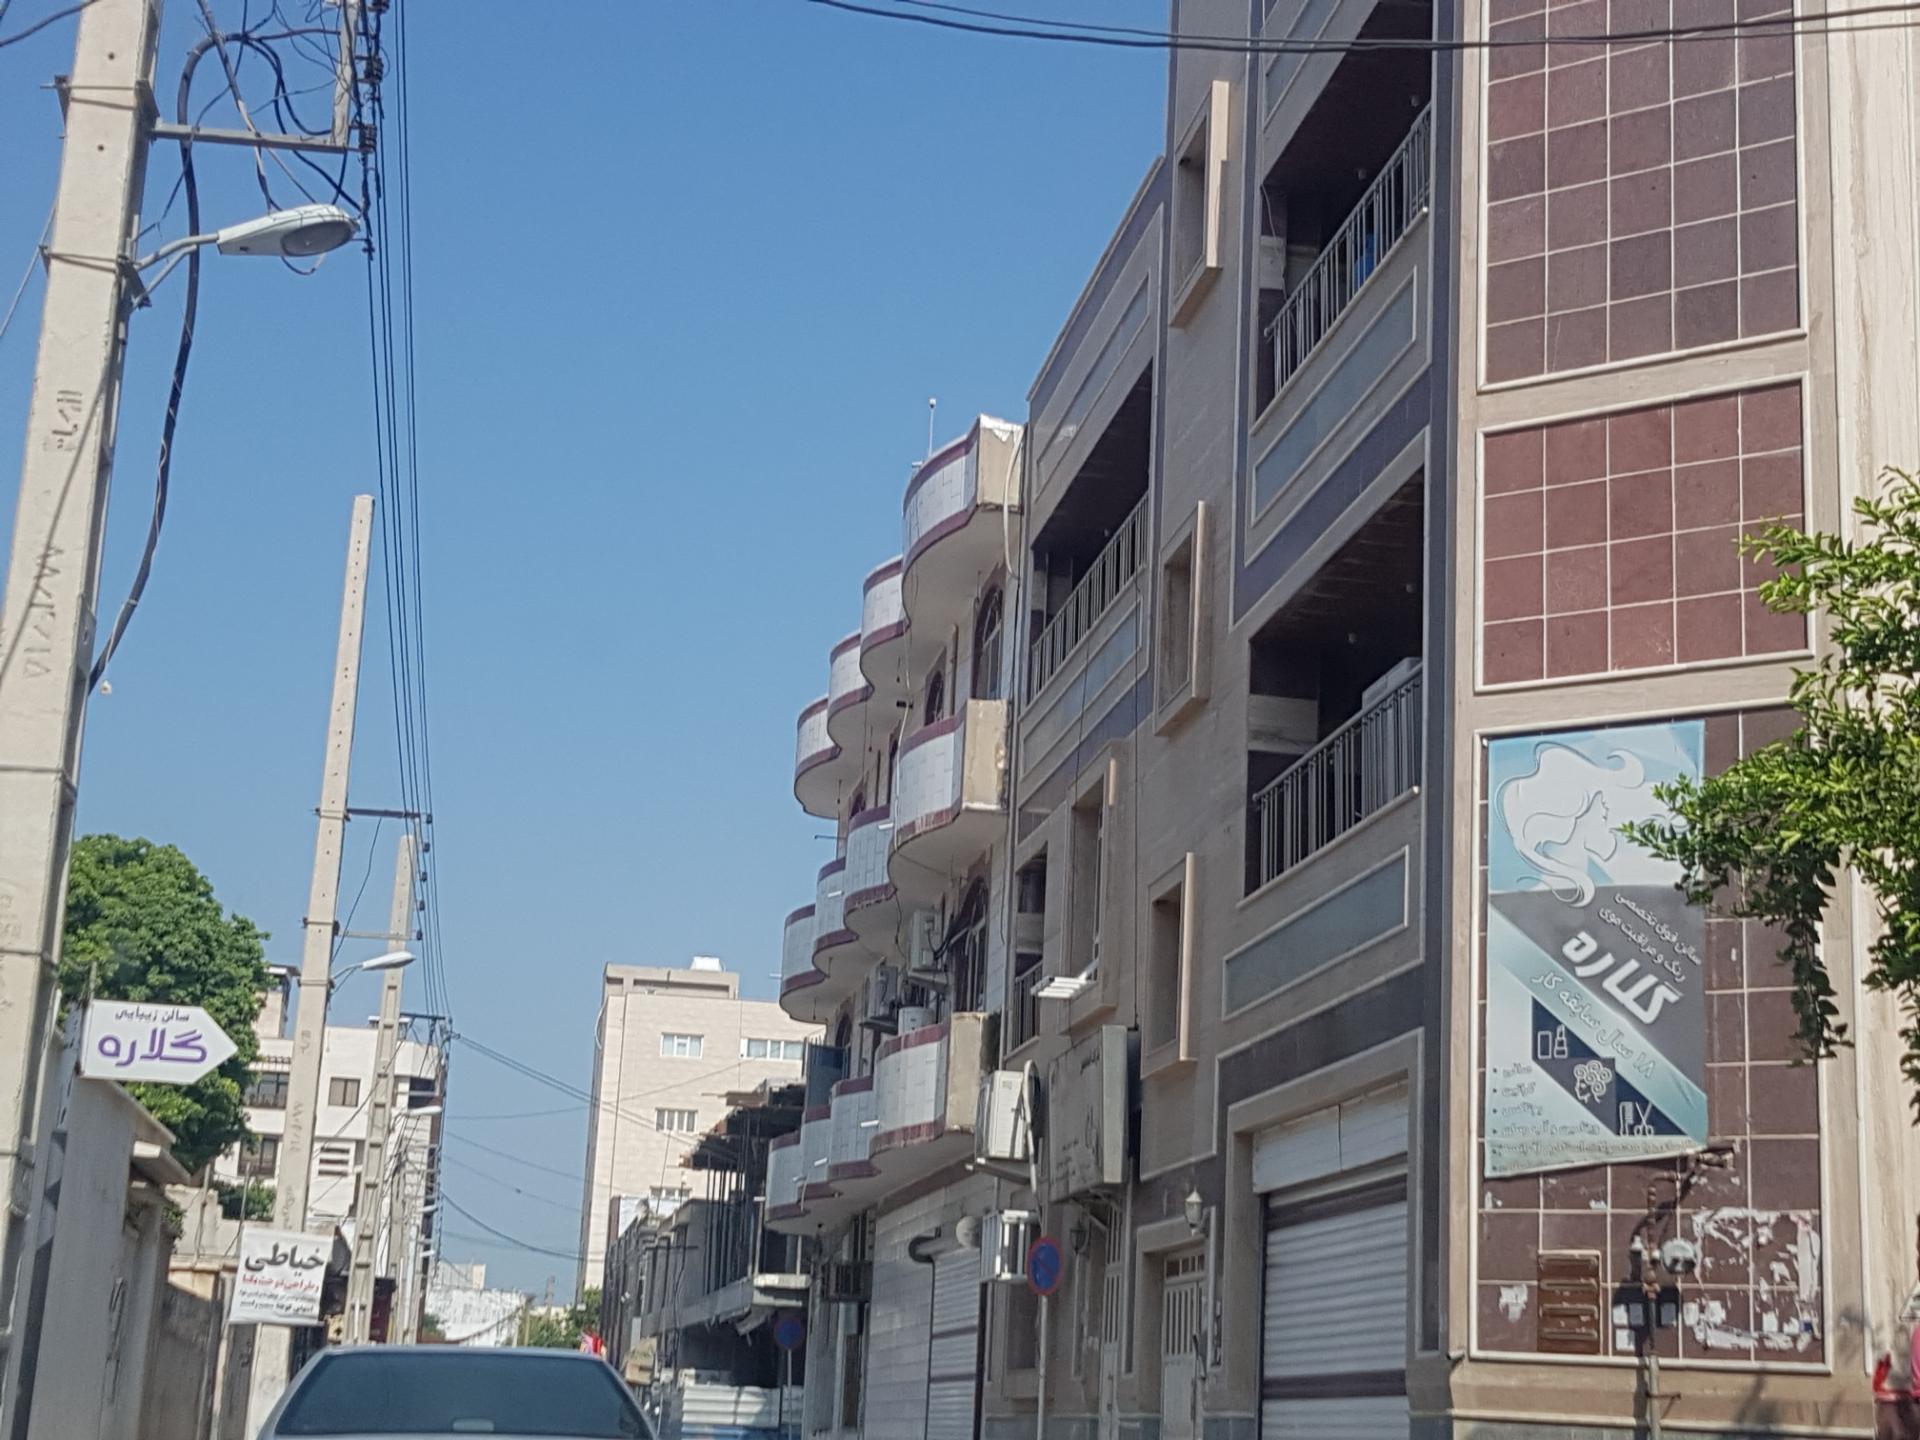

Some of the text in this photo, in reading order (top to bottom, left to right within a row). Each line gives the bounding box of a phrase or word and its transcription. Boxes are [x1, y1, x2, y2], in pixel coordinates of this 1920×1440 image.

[1614, 892, 1702, 966] سالن فوق تخصصی
[1652, 953, 1664, 964] و
[1532, 972, 1564, 989] کار
[115, 1006, 190, 1022] سالن زیبایی
[1559, 990, 1600, 1028] سابقه
[98, 1027, 208, 1067] گلاره
[1596, 1027, 1634, 1059] سال
[245, 1242, 325, 1277] خیاطی
